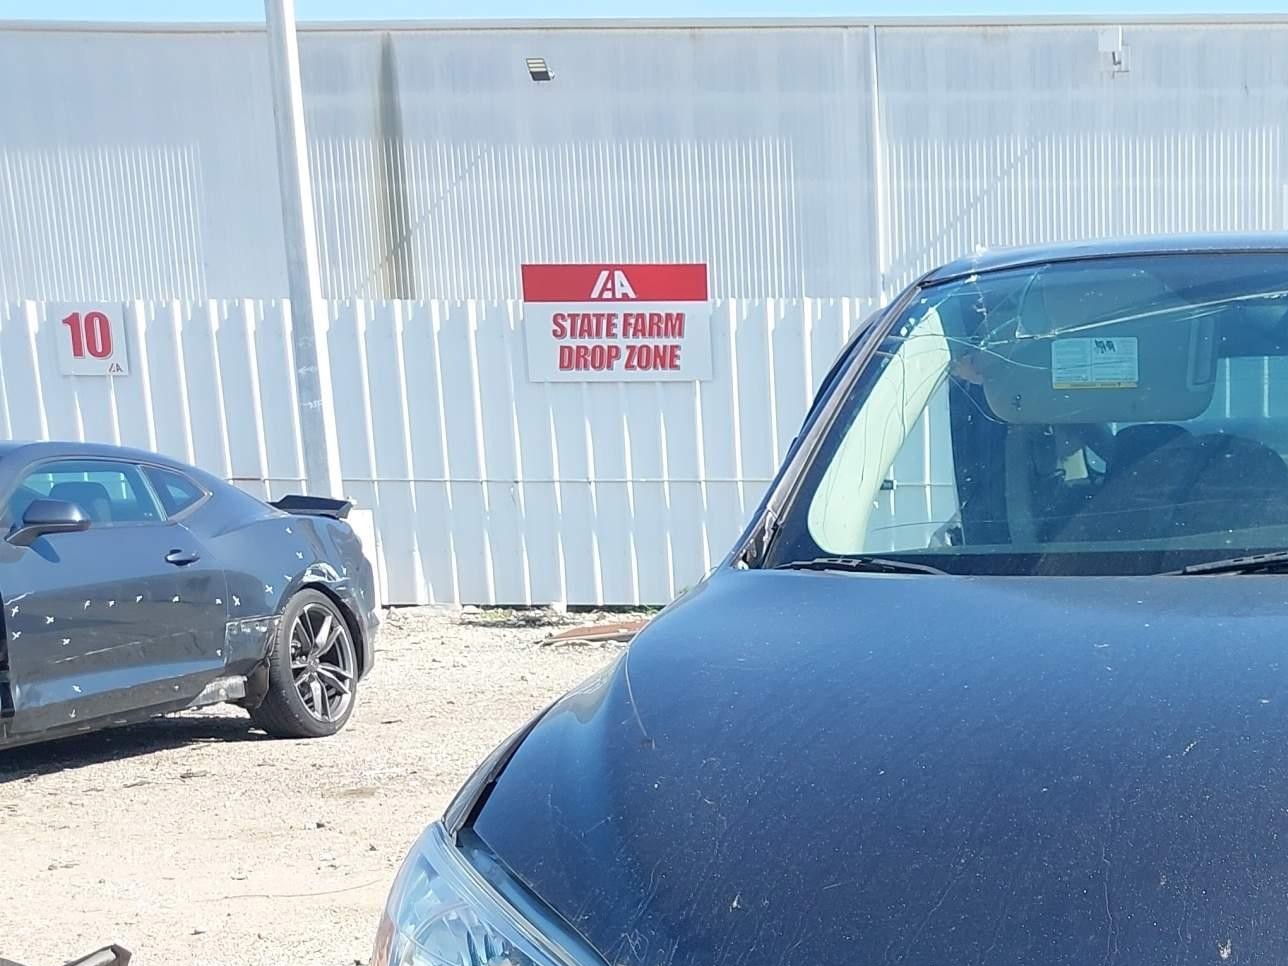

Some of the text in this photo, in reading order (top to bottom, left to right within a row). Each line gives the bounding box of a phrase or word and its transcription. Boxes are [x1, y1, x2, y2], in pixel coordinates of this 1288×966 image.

[61, 310, 113, 360] 10
[552, 312, 685, 340] STATE FARM
[559, 344, 681, 371] DROP ZONE
